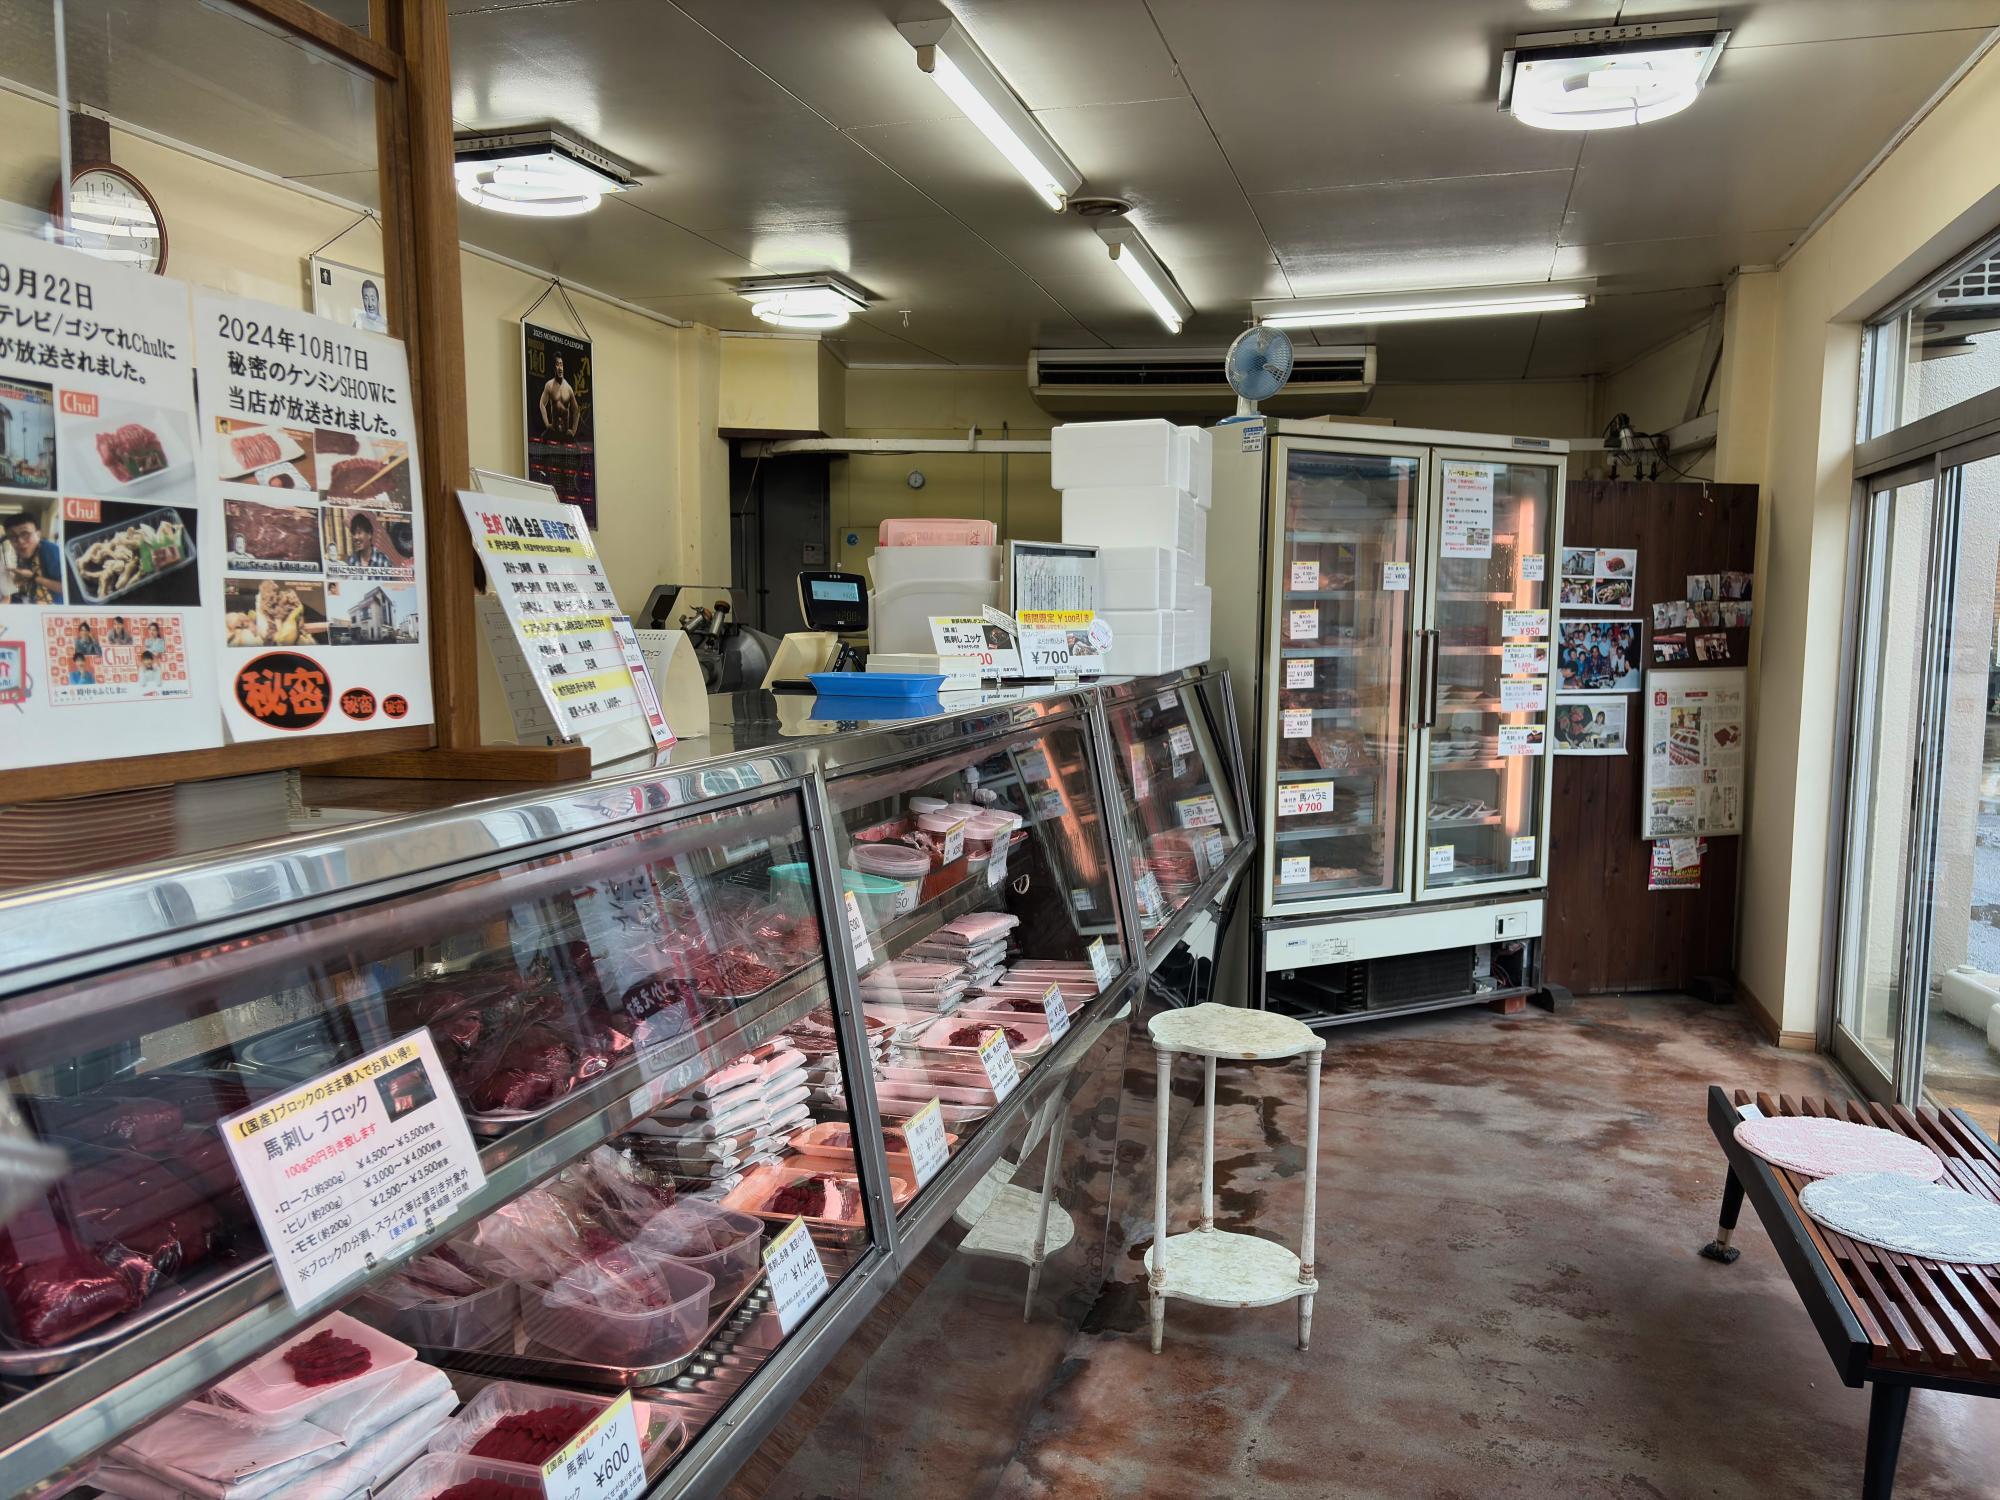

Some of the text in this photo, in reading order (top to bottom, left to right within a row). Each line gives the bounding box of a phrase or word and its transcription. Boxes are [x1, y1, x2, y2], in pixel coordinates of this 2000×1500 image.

[218, 314, 368, 371] 2024年10月17日
[227, 351, 397, 404] 秘密のケンミンSHOWに
[63, 393, 97, 414] Chu!
[229, 386, 396, 437] 当店が放送されました。
[66, 500, 98, 519] Chu!
[1024, 613, 1054, 623] 期間限定
[1520, 626, 1540, 635] ¥950
[964, 634, 981, 643] ユッケ
[104, 646, 132, 666] Chu!
[1031, 650, 1068, 664] ¥700
[241, 667, 325, 716] 秘密
[343, 695, 373, 714] 秘密
[1298, 802, 1322, 812] ¥700
[264, 1095, 368, 1160] 馬刺し ブロック
[284, 1123, 377, 1178] 100g50円引き致します
[790, 1248, 817, 1281] ¥1,440
[566, 1421, 617, 1480] 馬刺し ハツ
[593, 1443, 630, 1488] ¥600
